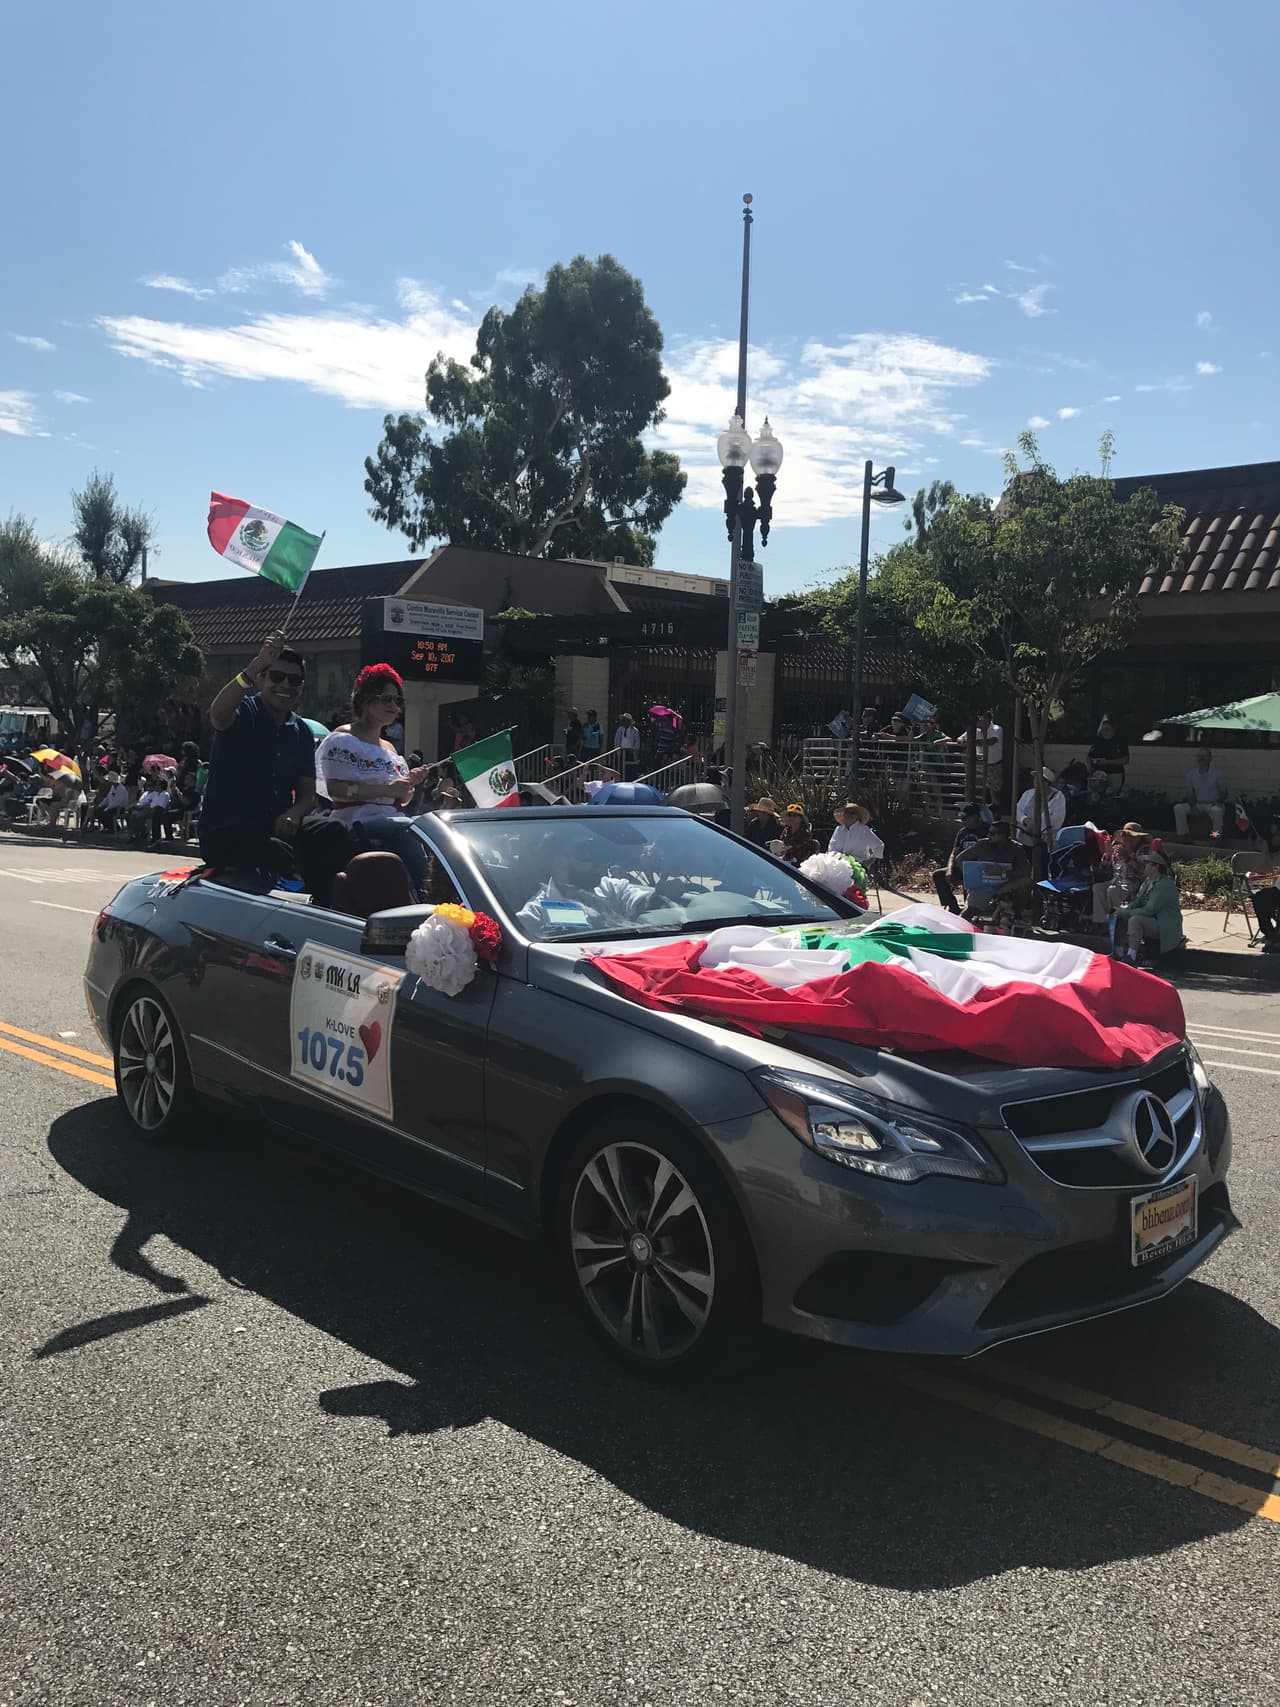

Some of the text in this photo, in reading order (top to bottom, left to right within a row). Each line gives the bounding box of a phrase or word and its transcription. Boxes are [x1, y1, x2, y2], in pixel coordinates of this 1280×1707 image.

[641, 621, 674, 635] 4716
[417, 640, 448, 651] 10:50 AM
[440, 653, 456, 663] 2017
[326, 1017, 355, 1039] K-LOVE
[298, 1026, 364, 1087] 107.5
[1142, 1244, 1172, 1261] Beverly
